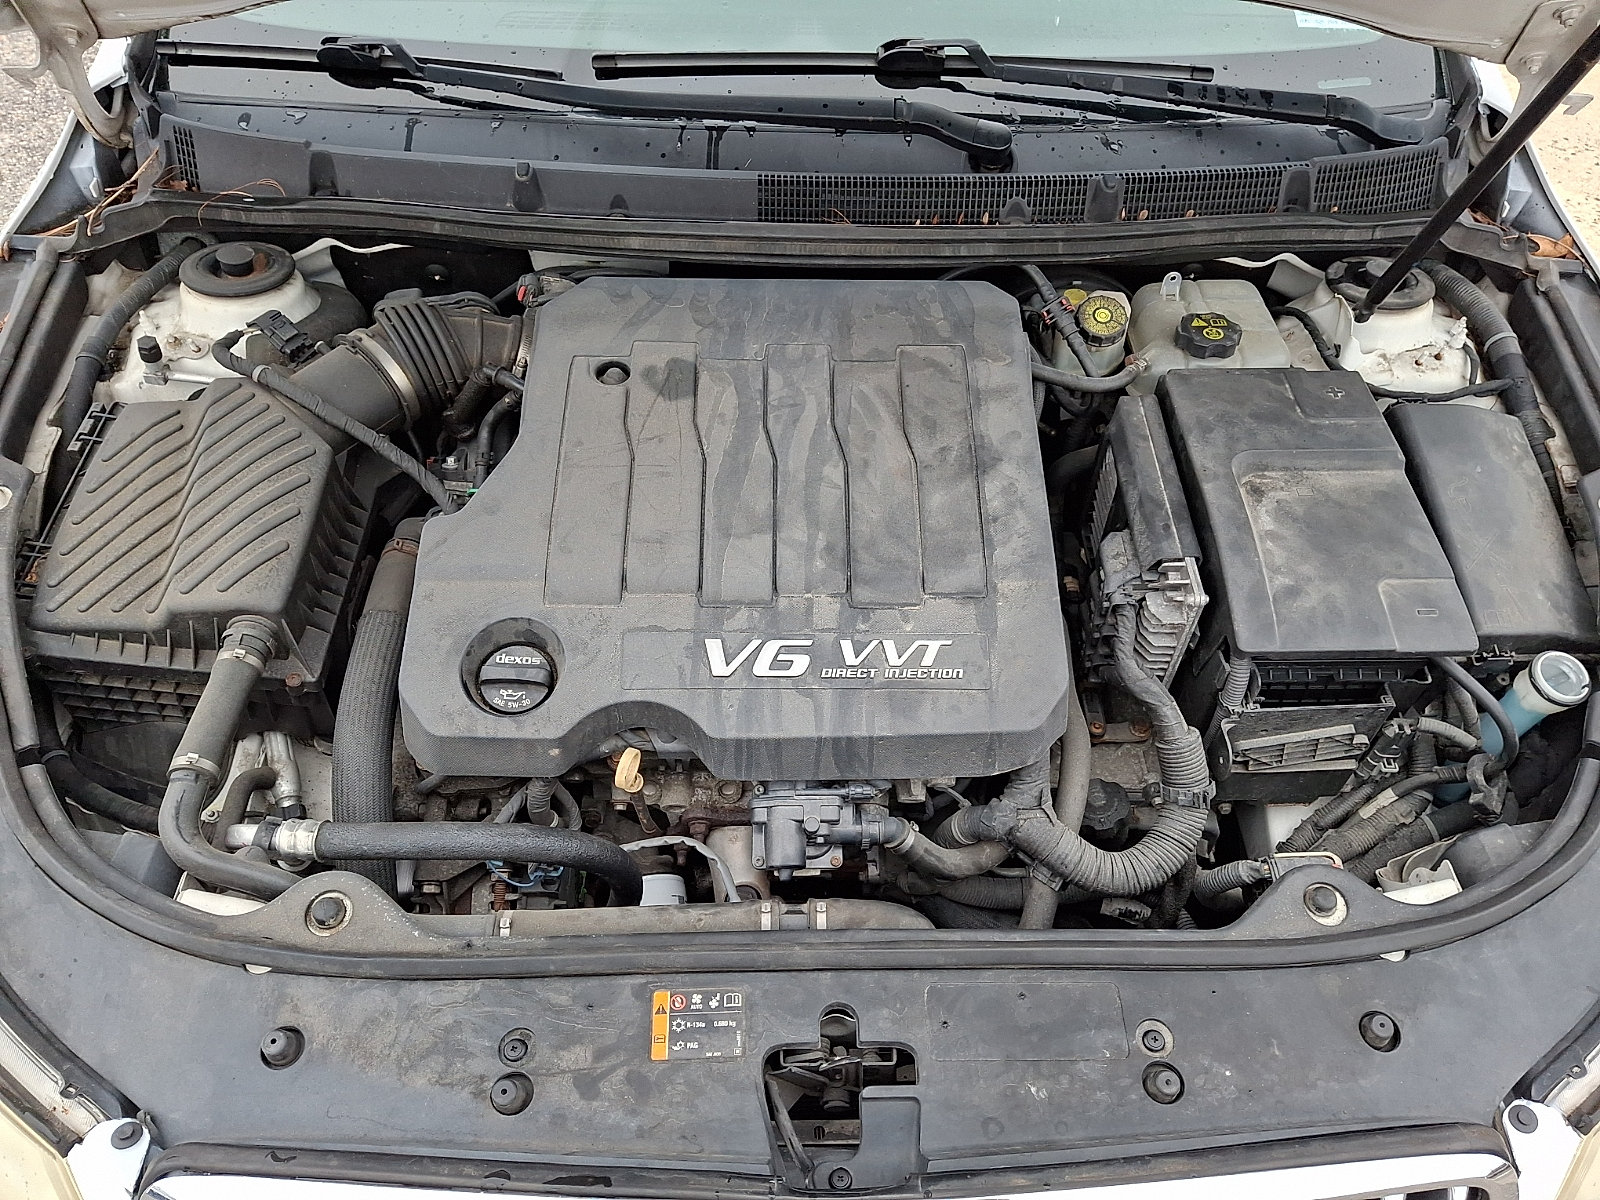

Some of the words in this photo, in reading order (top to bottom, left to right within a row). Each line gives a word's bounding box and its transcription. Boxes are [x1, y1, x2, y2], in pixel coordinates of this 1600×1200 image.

[495, 653, 542, 665] dexos
[704, 638, 814, 678] V6
[839, 639, 953, 667] VVT
[821, 668, 878, 679] DIRECT
[884, 668, 964, 679] INJECTION
[493, 697, 506, 707] SAE
[507, 698, 531, 709] 5W-30
